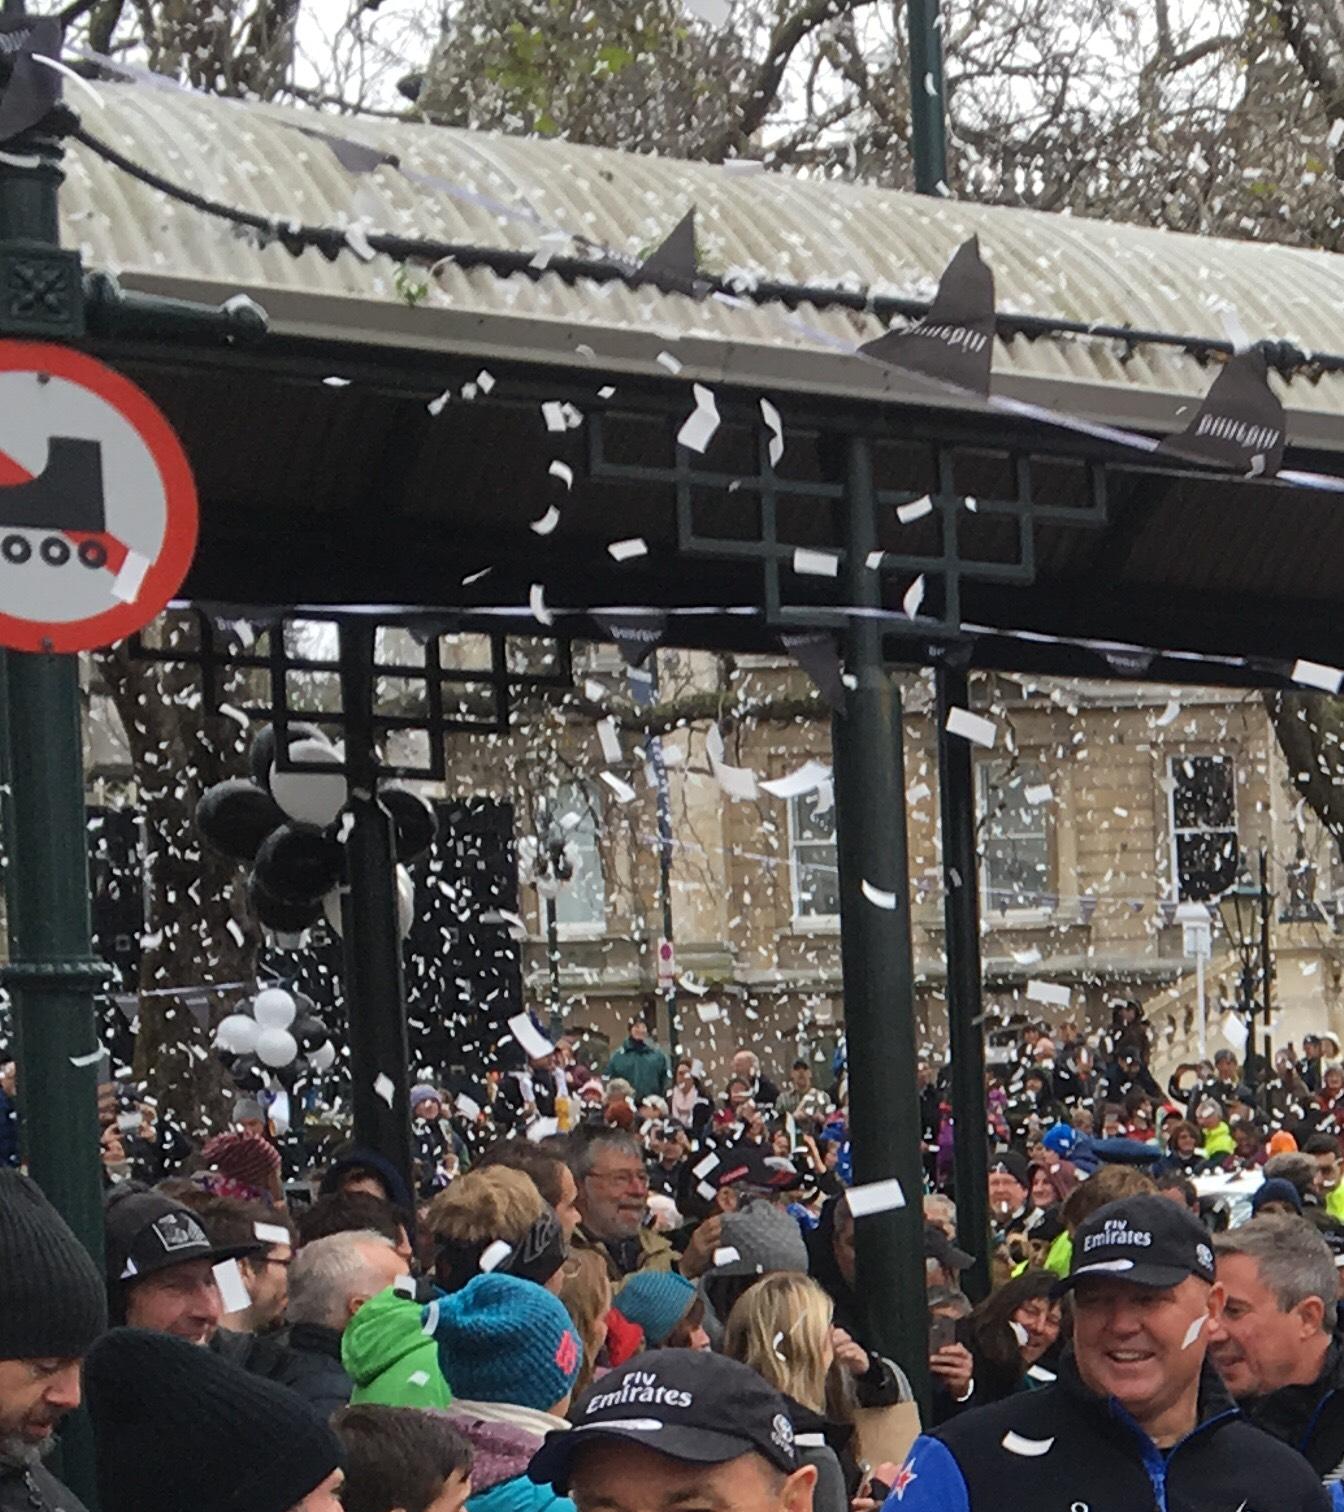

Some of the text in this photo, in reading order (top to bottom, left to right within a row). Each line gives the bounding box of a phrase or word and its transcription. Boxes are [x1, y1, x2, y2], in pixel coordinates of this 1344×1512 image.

[1104, 1219, 1128, 1231] Fly
[1084, 1229, 1152, 1252] Emirates
[622, 1371, 656, 1386] Fly
[585, 1385, 693, 1415] Emirates
